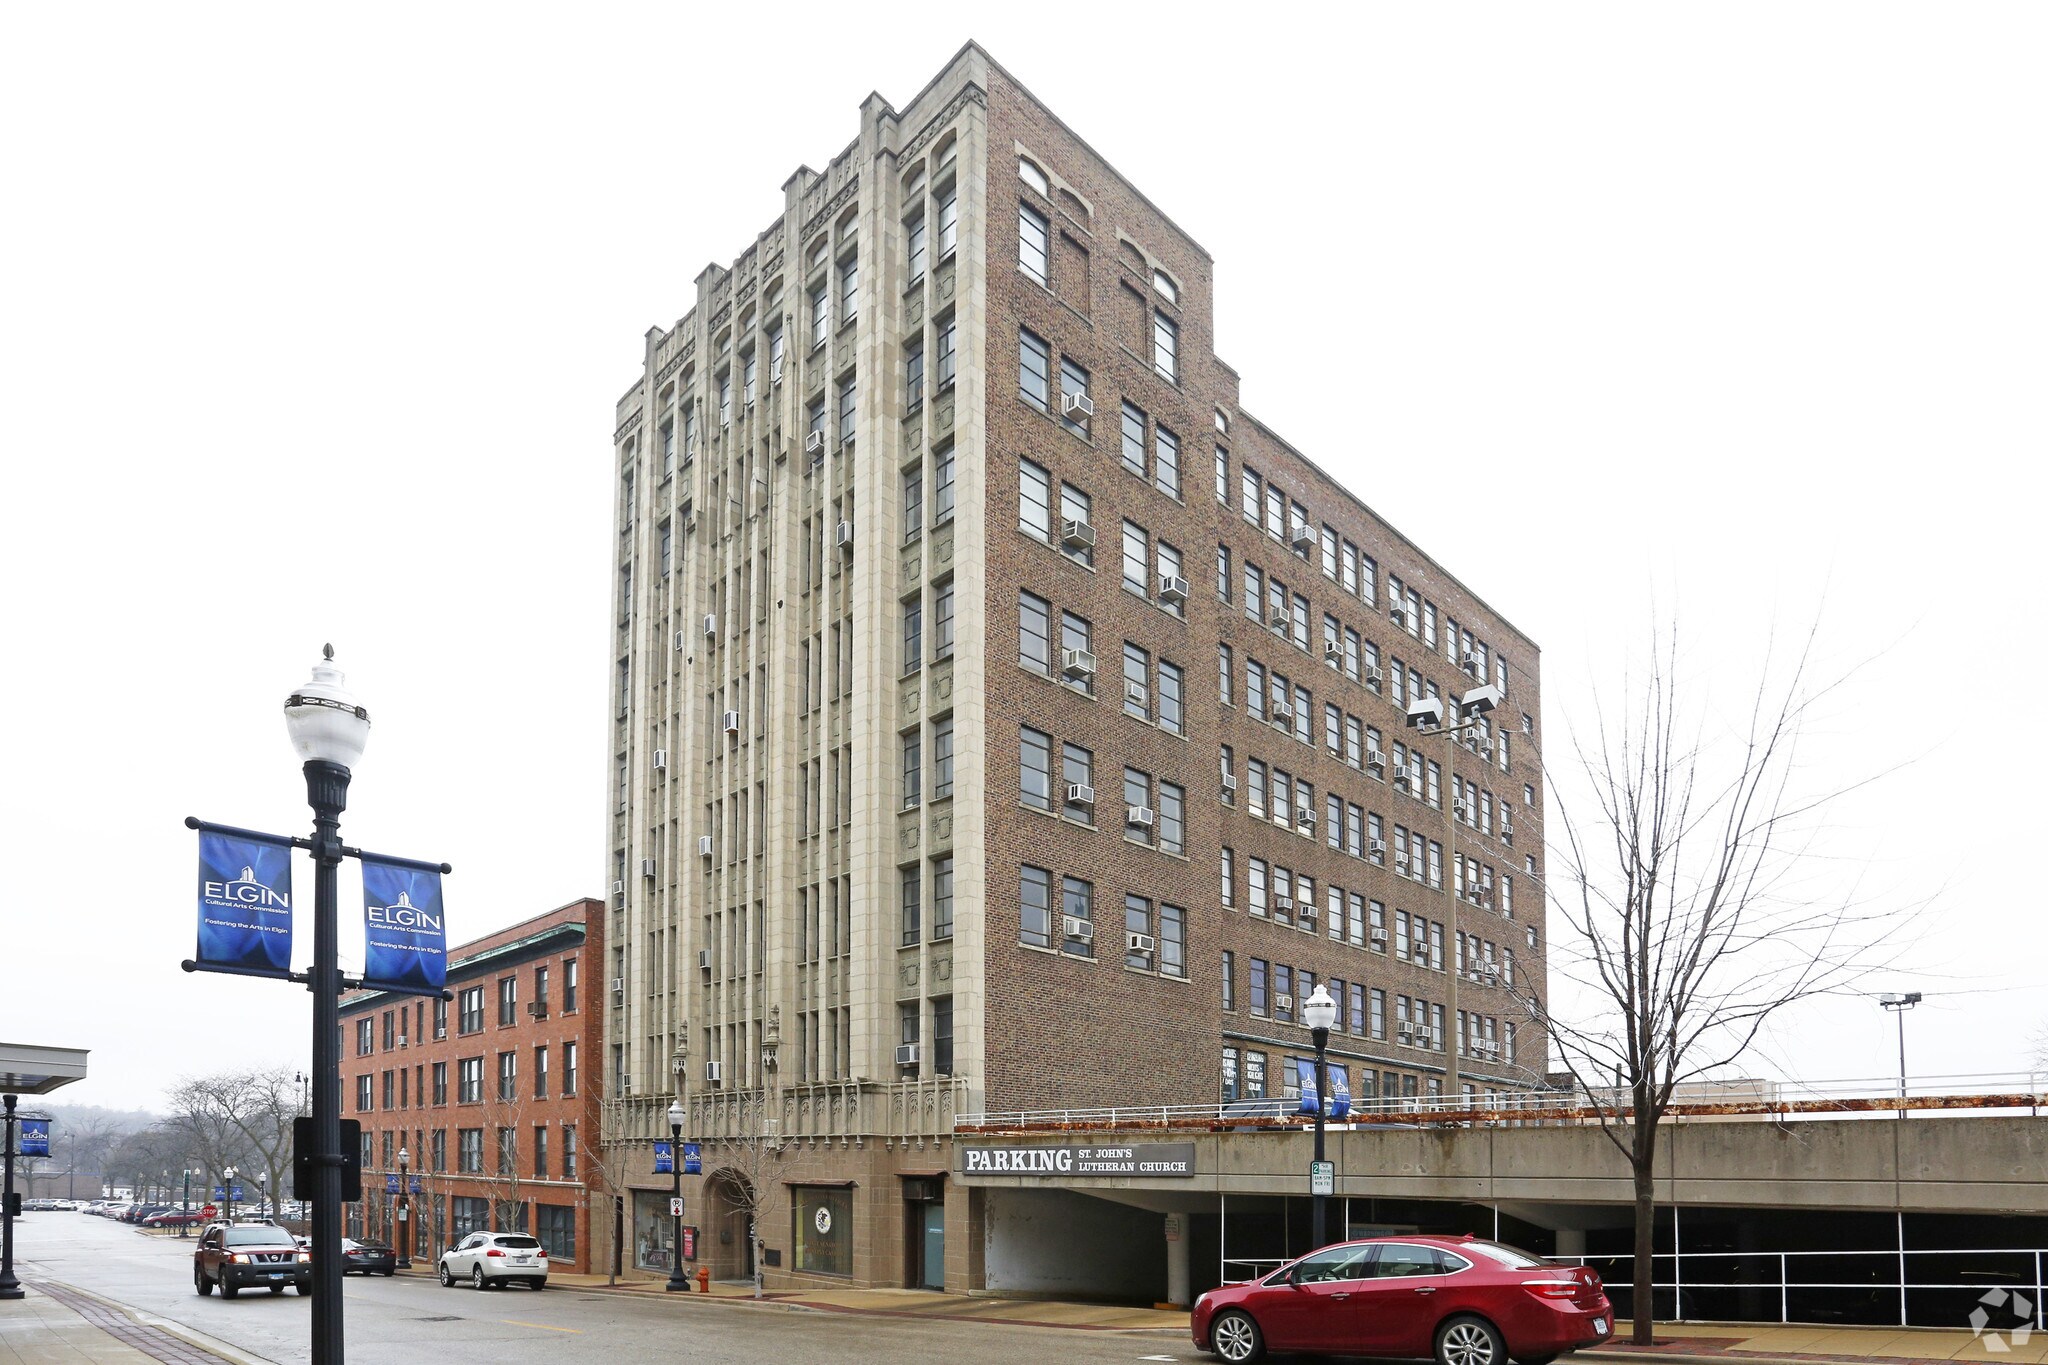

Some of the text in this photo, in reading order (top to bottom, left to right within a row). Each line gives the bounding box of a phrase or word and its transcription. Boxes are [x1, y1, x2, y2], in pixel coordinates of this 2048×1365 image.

[205, 881, 289, 908] ELGIN
[205, 899, 233, 907] Cultural
[248, 905, 289, 915] Commission
[205, 918, 237, 928] Fostering
[368, 906, 441, 930] ELGIN
[369, 922, 393, 930] Cultural
[406, 927, 441, 936] Commission
[370, 941, 398, 949] Fostering
[1078, 1148, 1133, 1159] ST. JOHN'S
[966, 1149, 1073, 1171] PARKING
[1078, 1162, 1187, 1172] LUTHERAN CHURCH
[1313, 1164, 1319, 1173] 2
